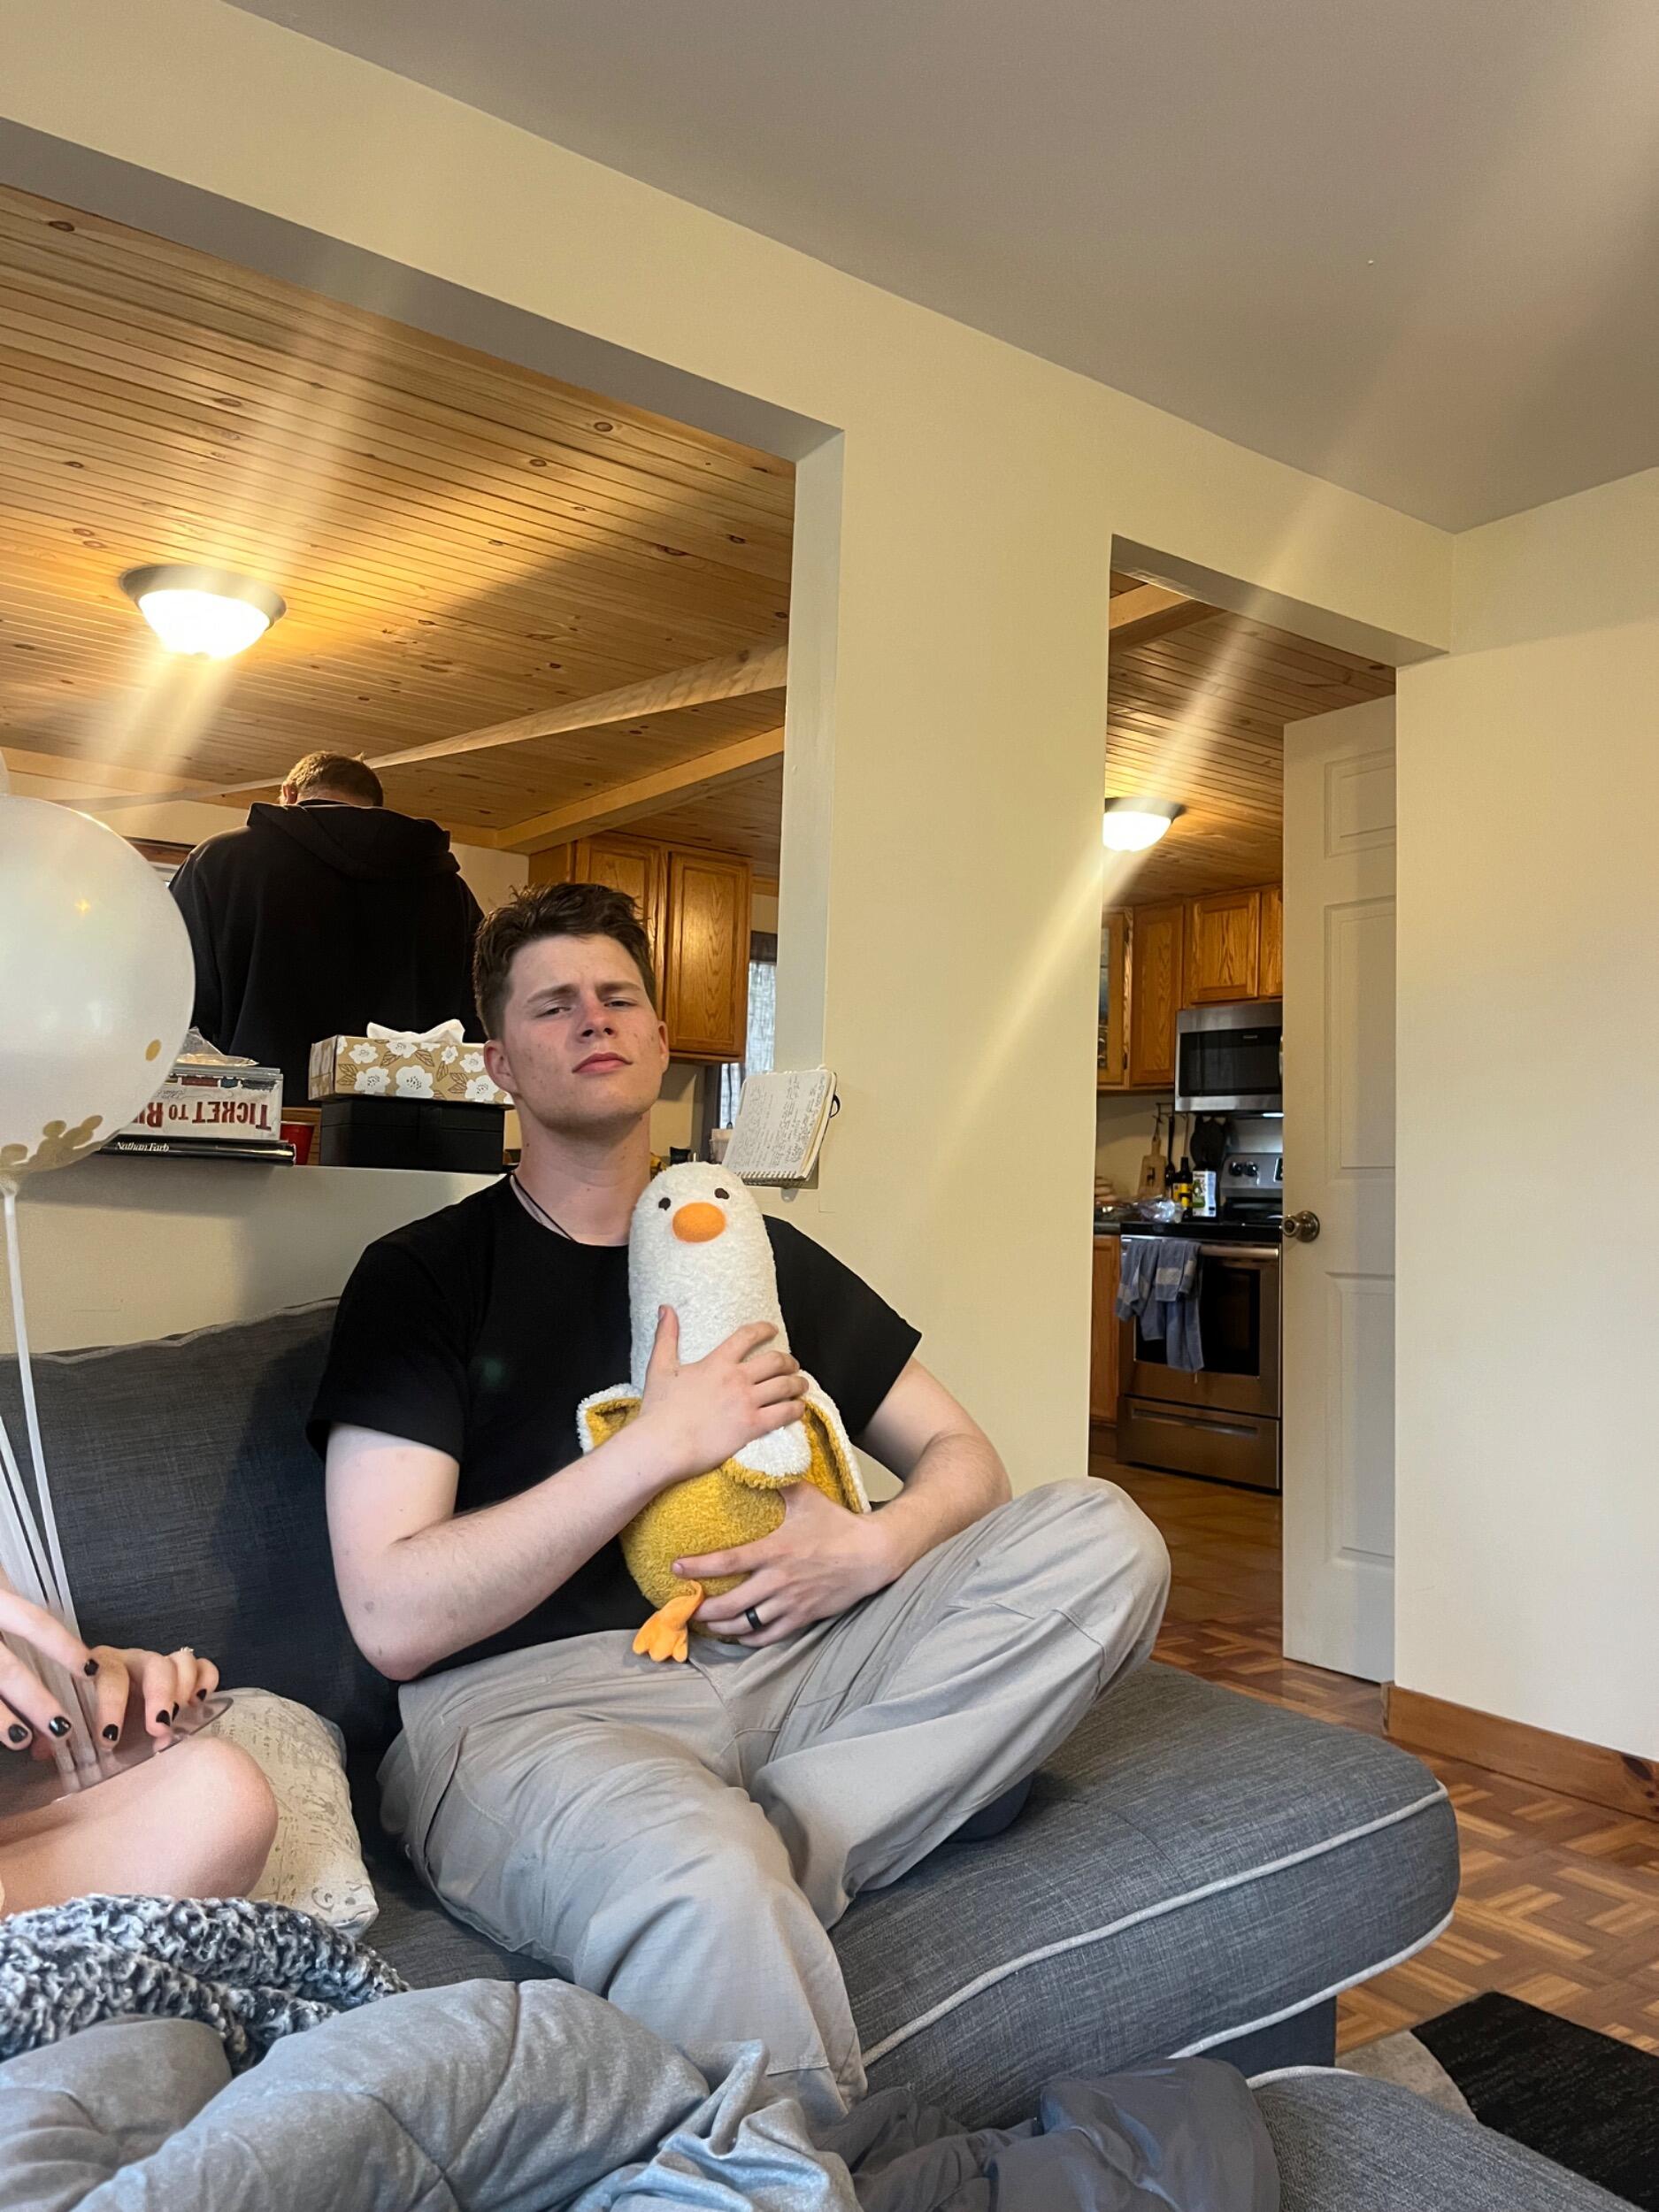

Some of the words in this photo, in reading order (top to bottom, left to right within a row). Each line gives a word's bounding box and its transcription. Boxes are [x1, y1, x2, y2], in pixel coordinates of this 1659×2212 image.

[133, 1102, 164, 1128] RI
[168, 1103, 188, 1121] TO
[192, 1101, 272, 1131] TICKET
[115, 1141, 148, 1151] Nathan
[149, 1142, 170, 1152] Farb
